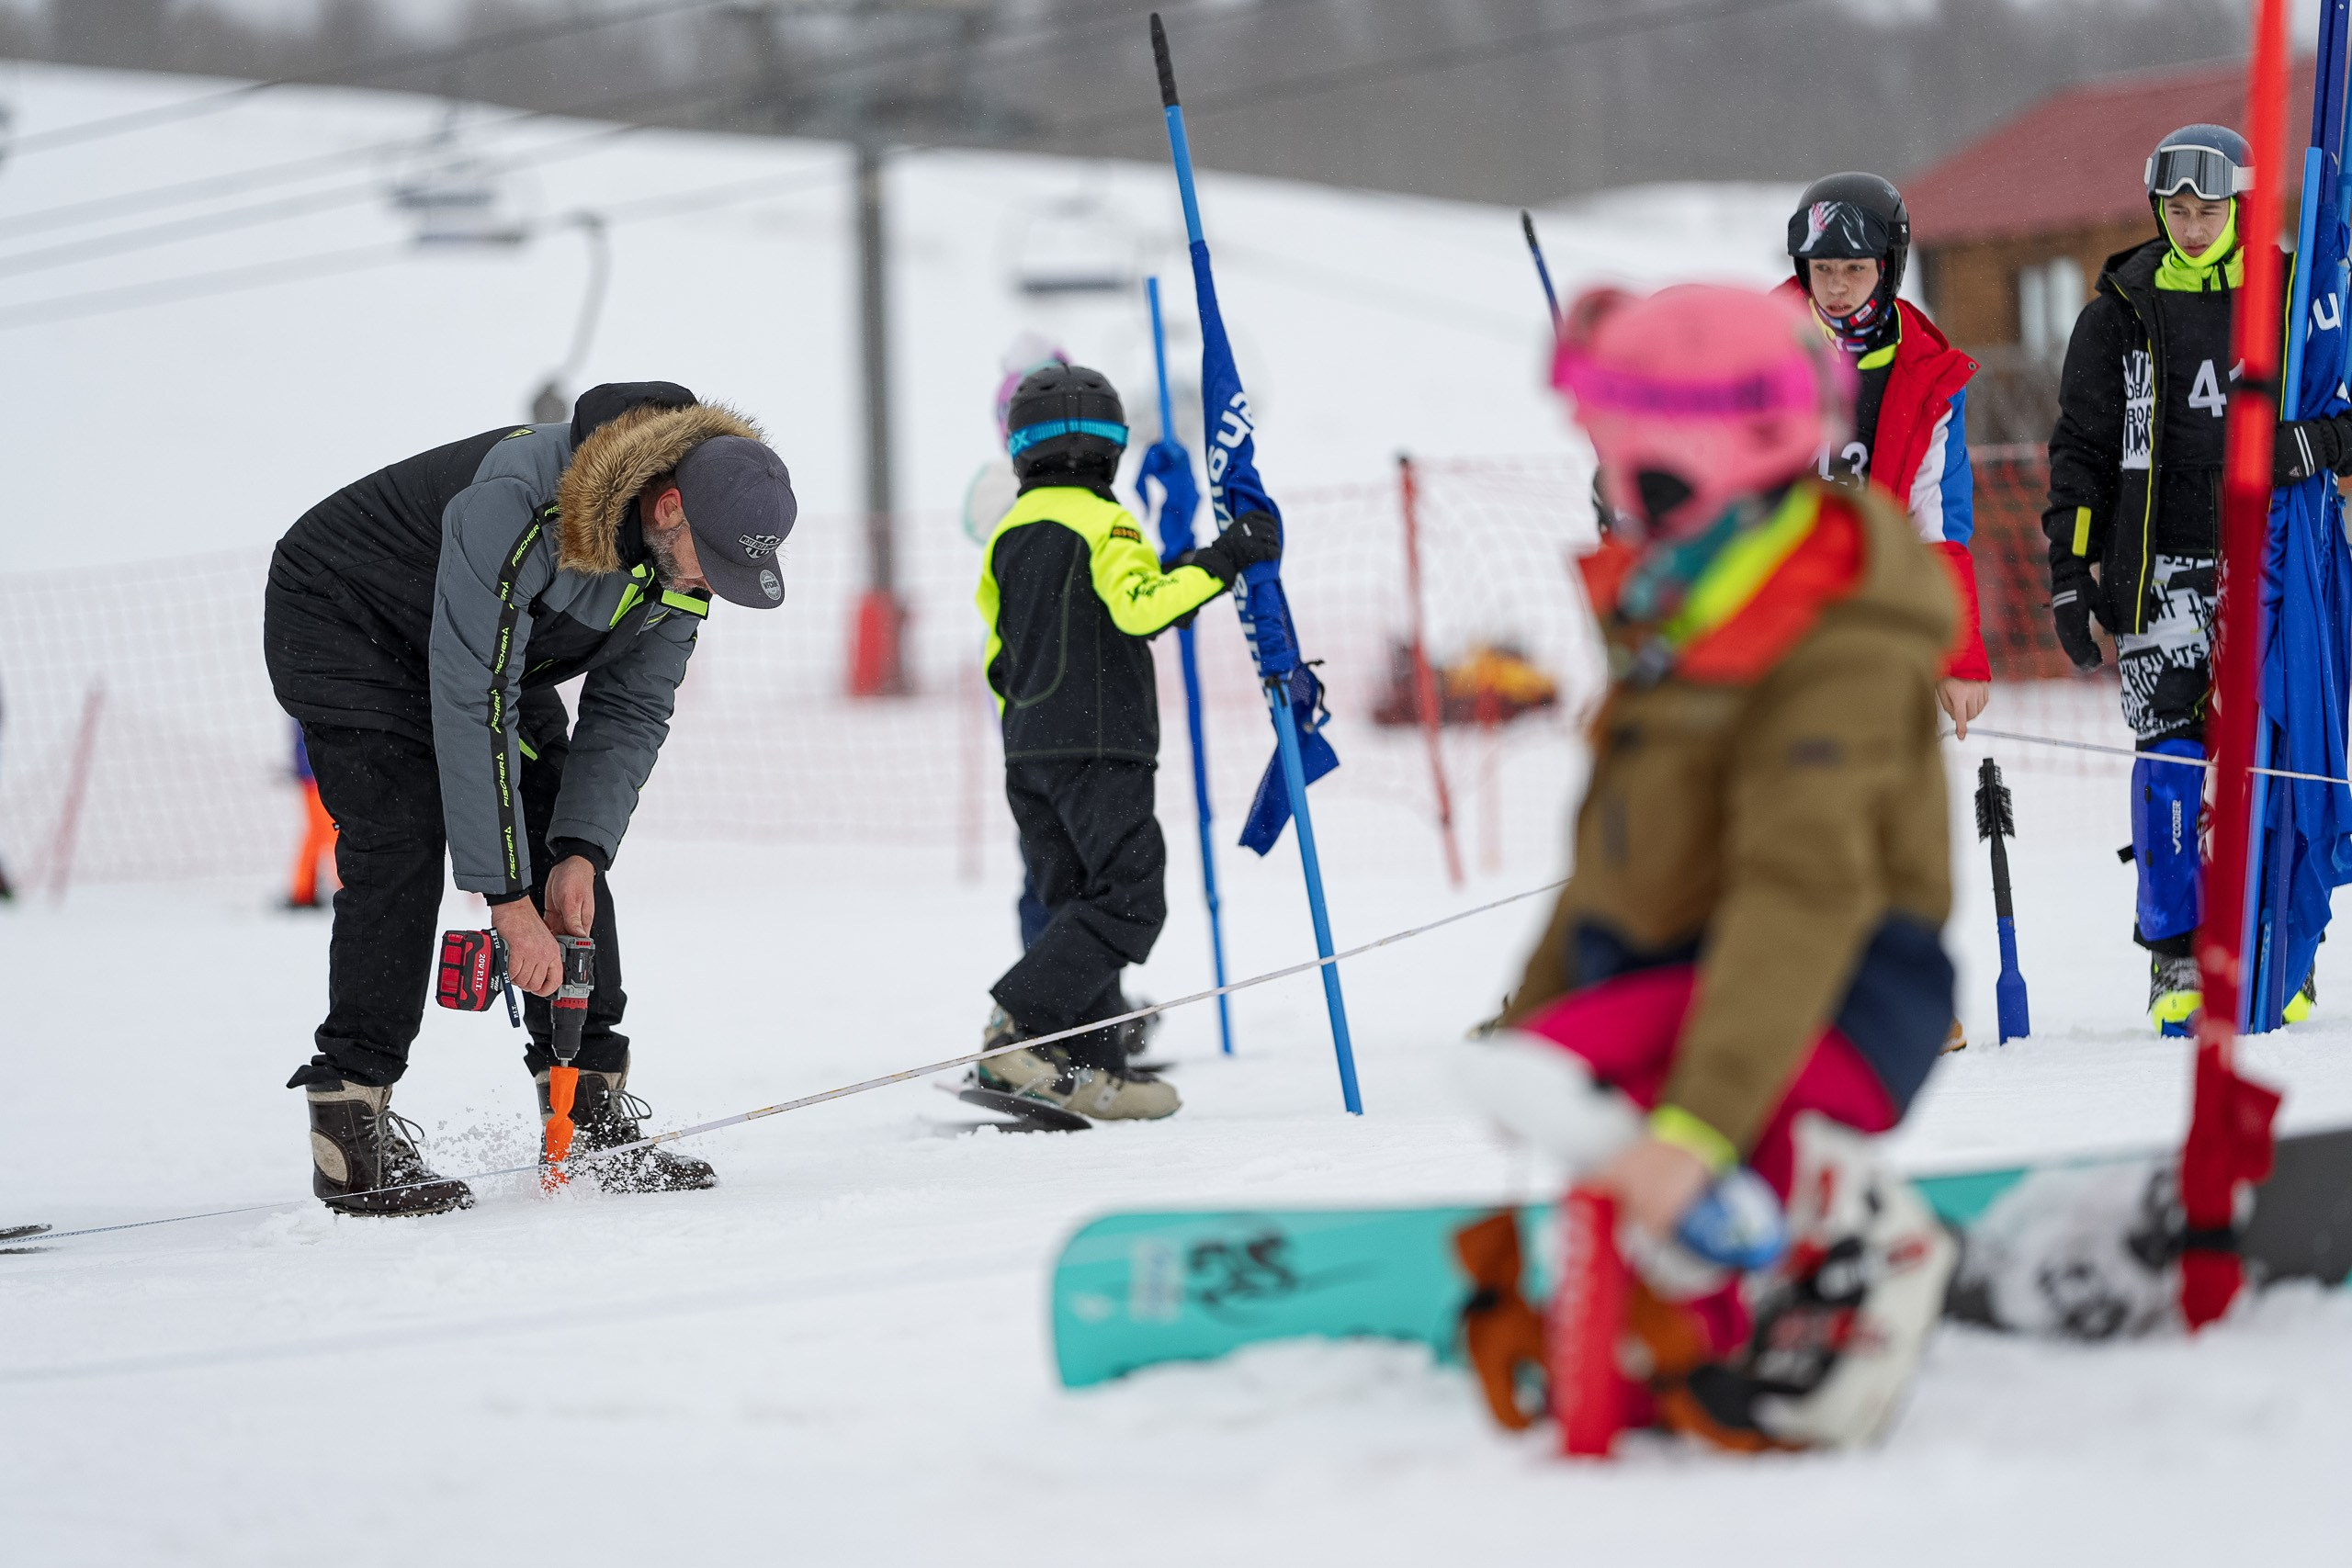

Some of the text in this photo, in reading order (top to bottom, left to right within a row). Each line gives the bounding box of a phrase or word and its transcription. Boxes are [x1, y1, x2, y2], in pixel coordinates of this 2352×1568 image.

[512, 525, 540, 567] FISCHER
[499, 761, 509, 807] FISCHER
[506, 834, 516, 879] FISCHER
[475, 970, 484, 991] P.I.T.
